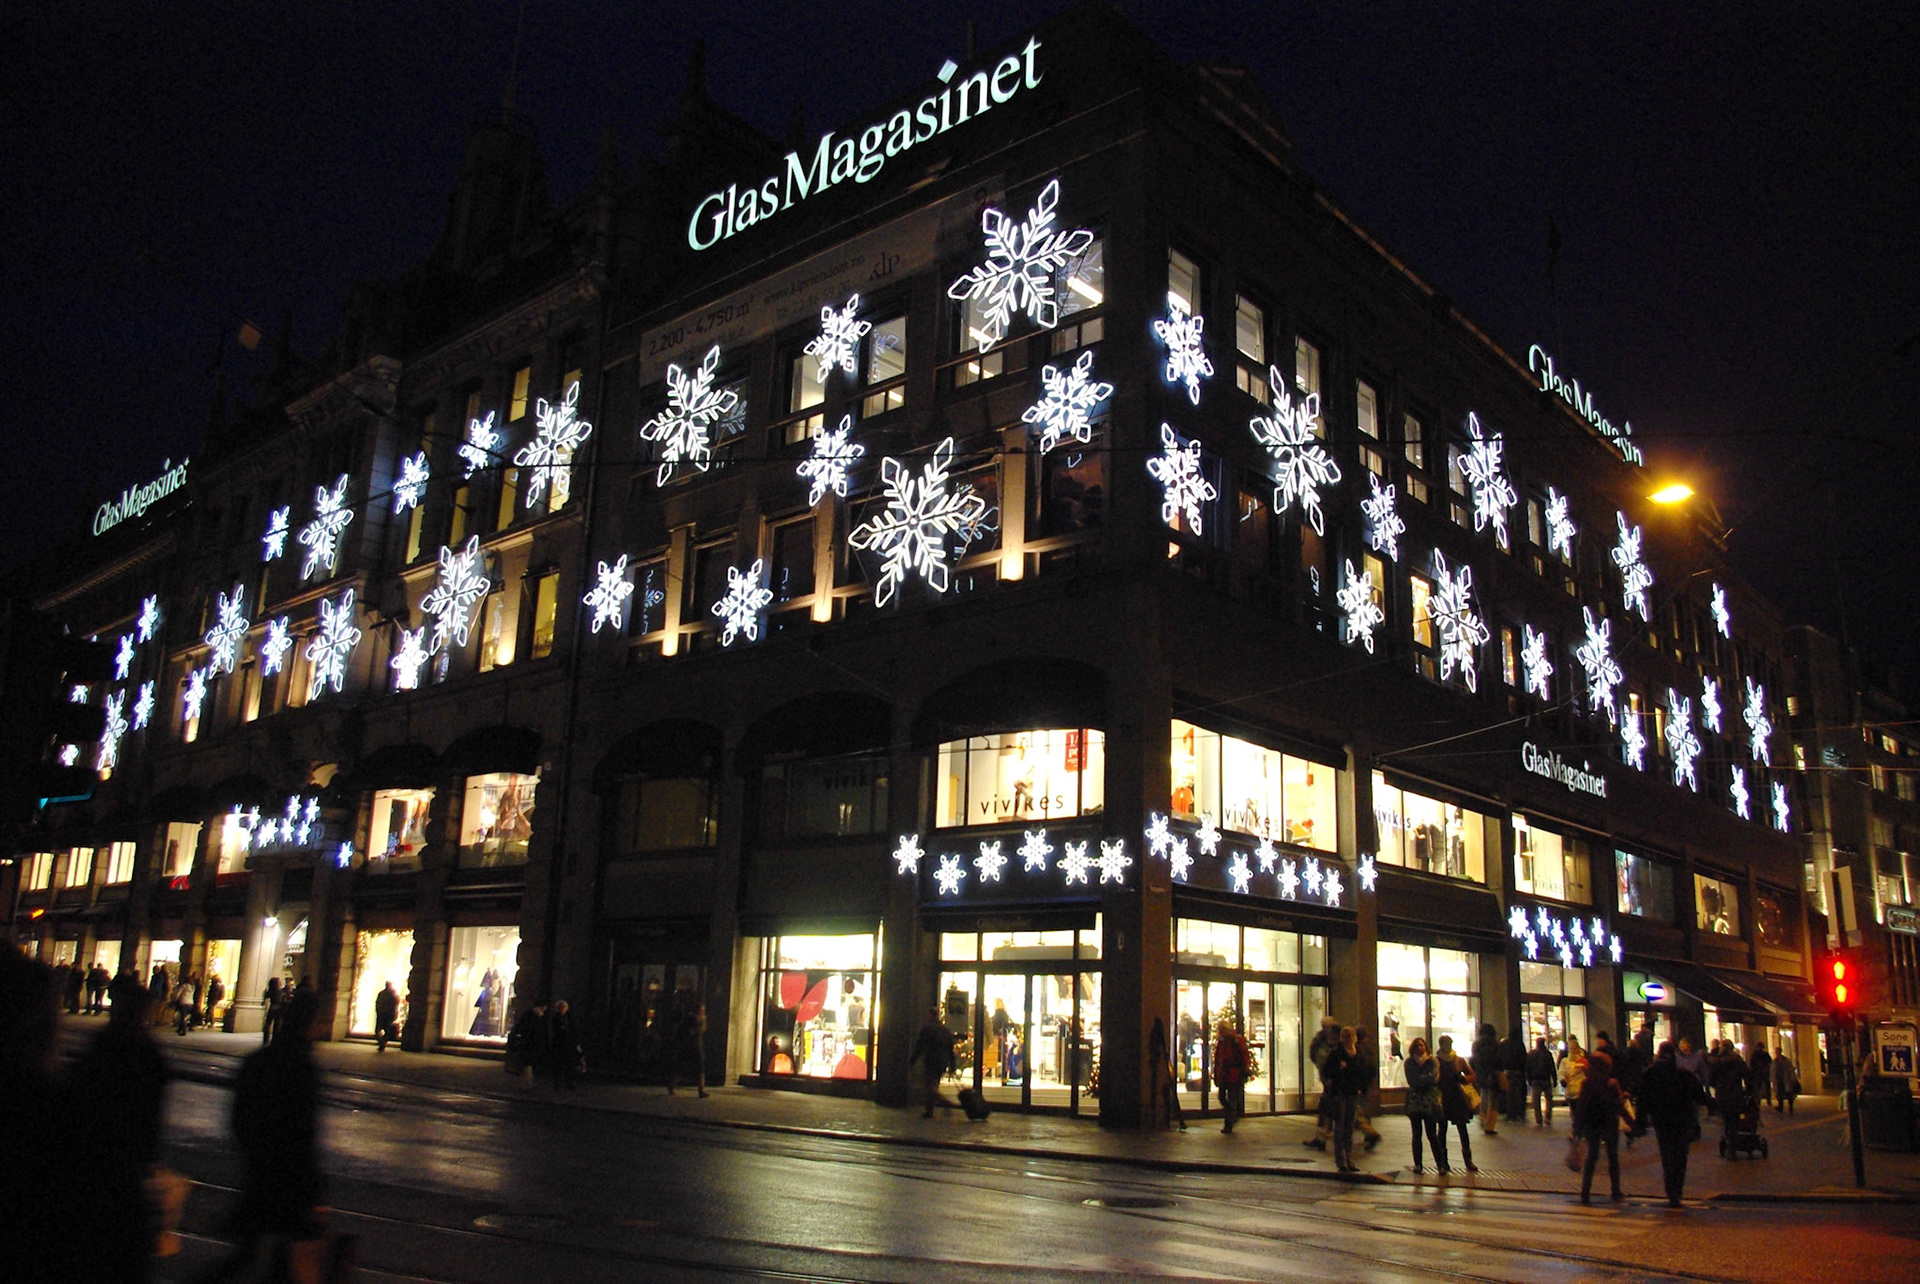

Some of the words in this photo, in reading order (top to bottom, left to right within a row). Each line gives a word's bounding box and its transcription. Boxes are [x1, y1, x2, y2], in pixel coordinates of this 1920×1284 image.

[687, 36, 1045, 251] GlasMagasinet
[94, 456, 191, 536] GlasMagasinet
[1522, 741, 1606, 798] GlasMagasinet
[980, 794, 1065, 815] vivikes
[1883, 1032, 1908, 1041] Sone
